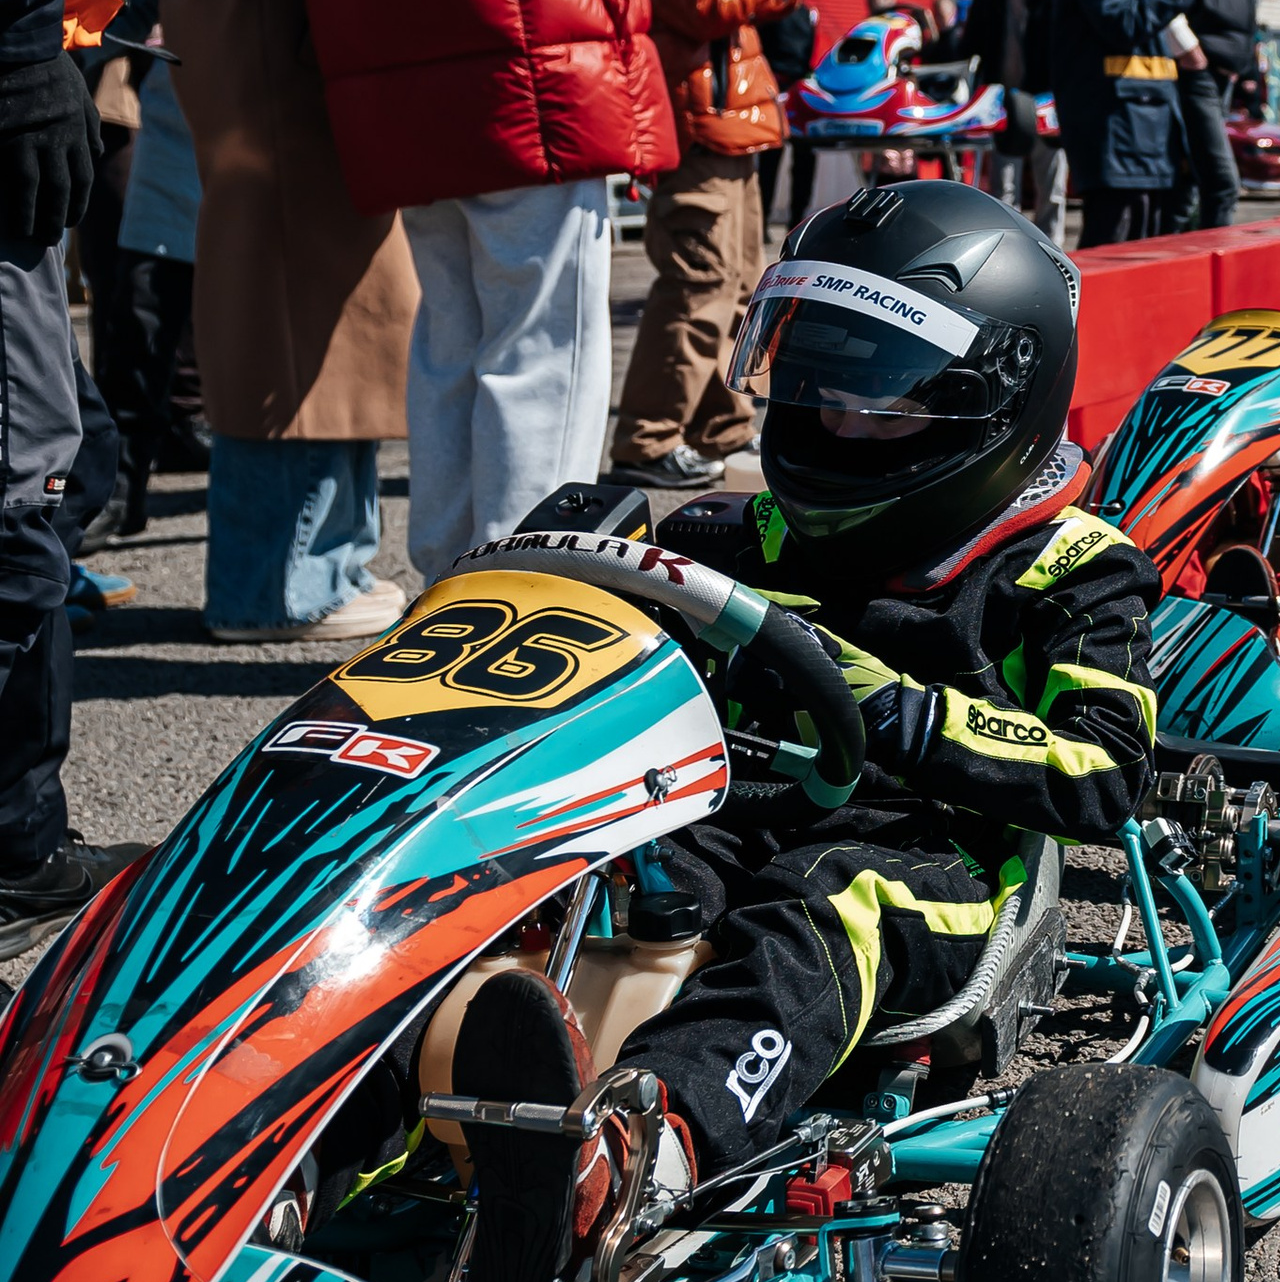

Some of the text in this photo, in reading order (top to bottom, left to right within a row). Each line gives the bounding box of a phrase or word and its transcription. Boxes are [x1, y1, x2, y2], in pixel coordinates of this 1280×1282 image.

[811, 274, 855, 293] SMP
[852, 284, 928, 327] RACING
[453, 534, 695, 586] FORMULA K
[1047, 530, 1104, 578] sparco
[335, 598, 631, 702] 86
[966, 703, 1048, 744] sparco
